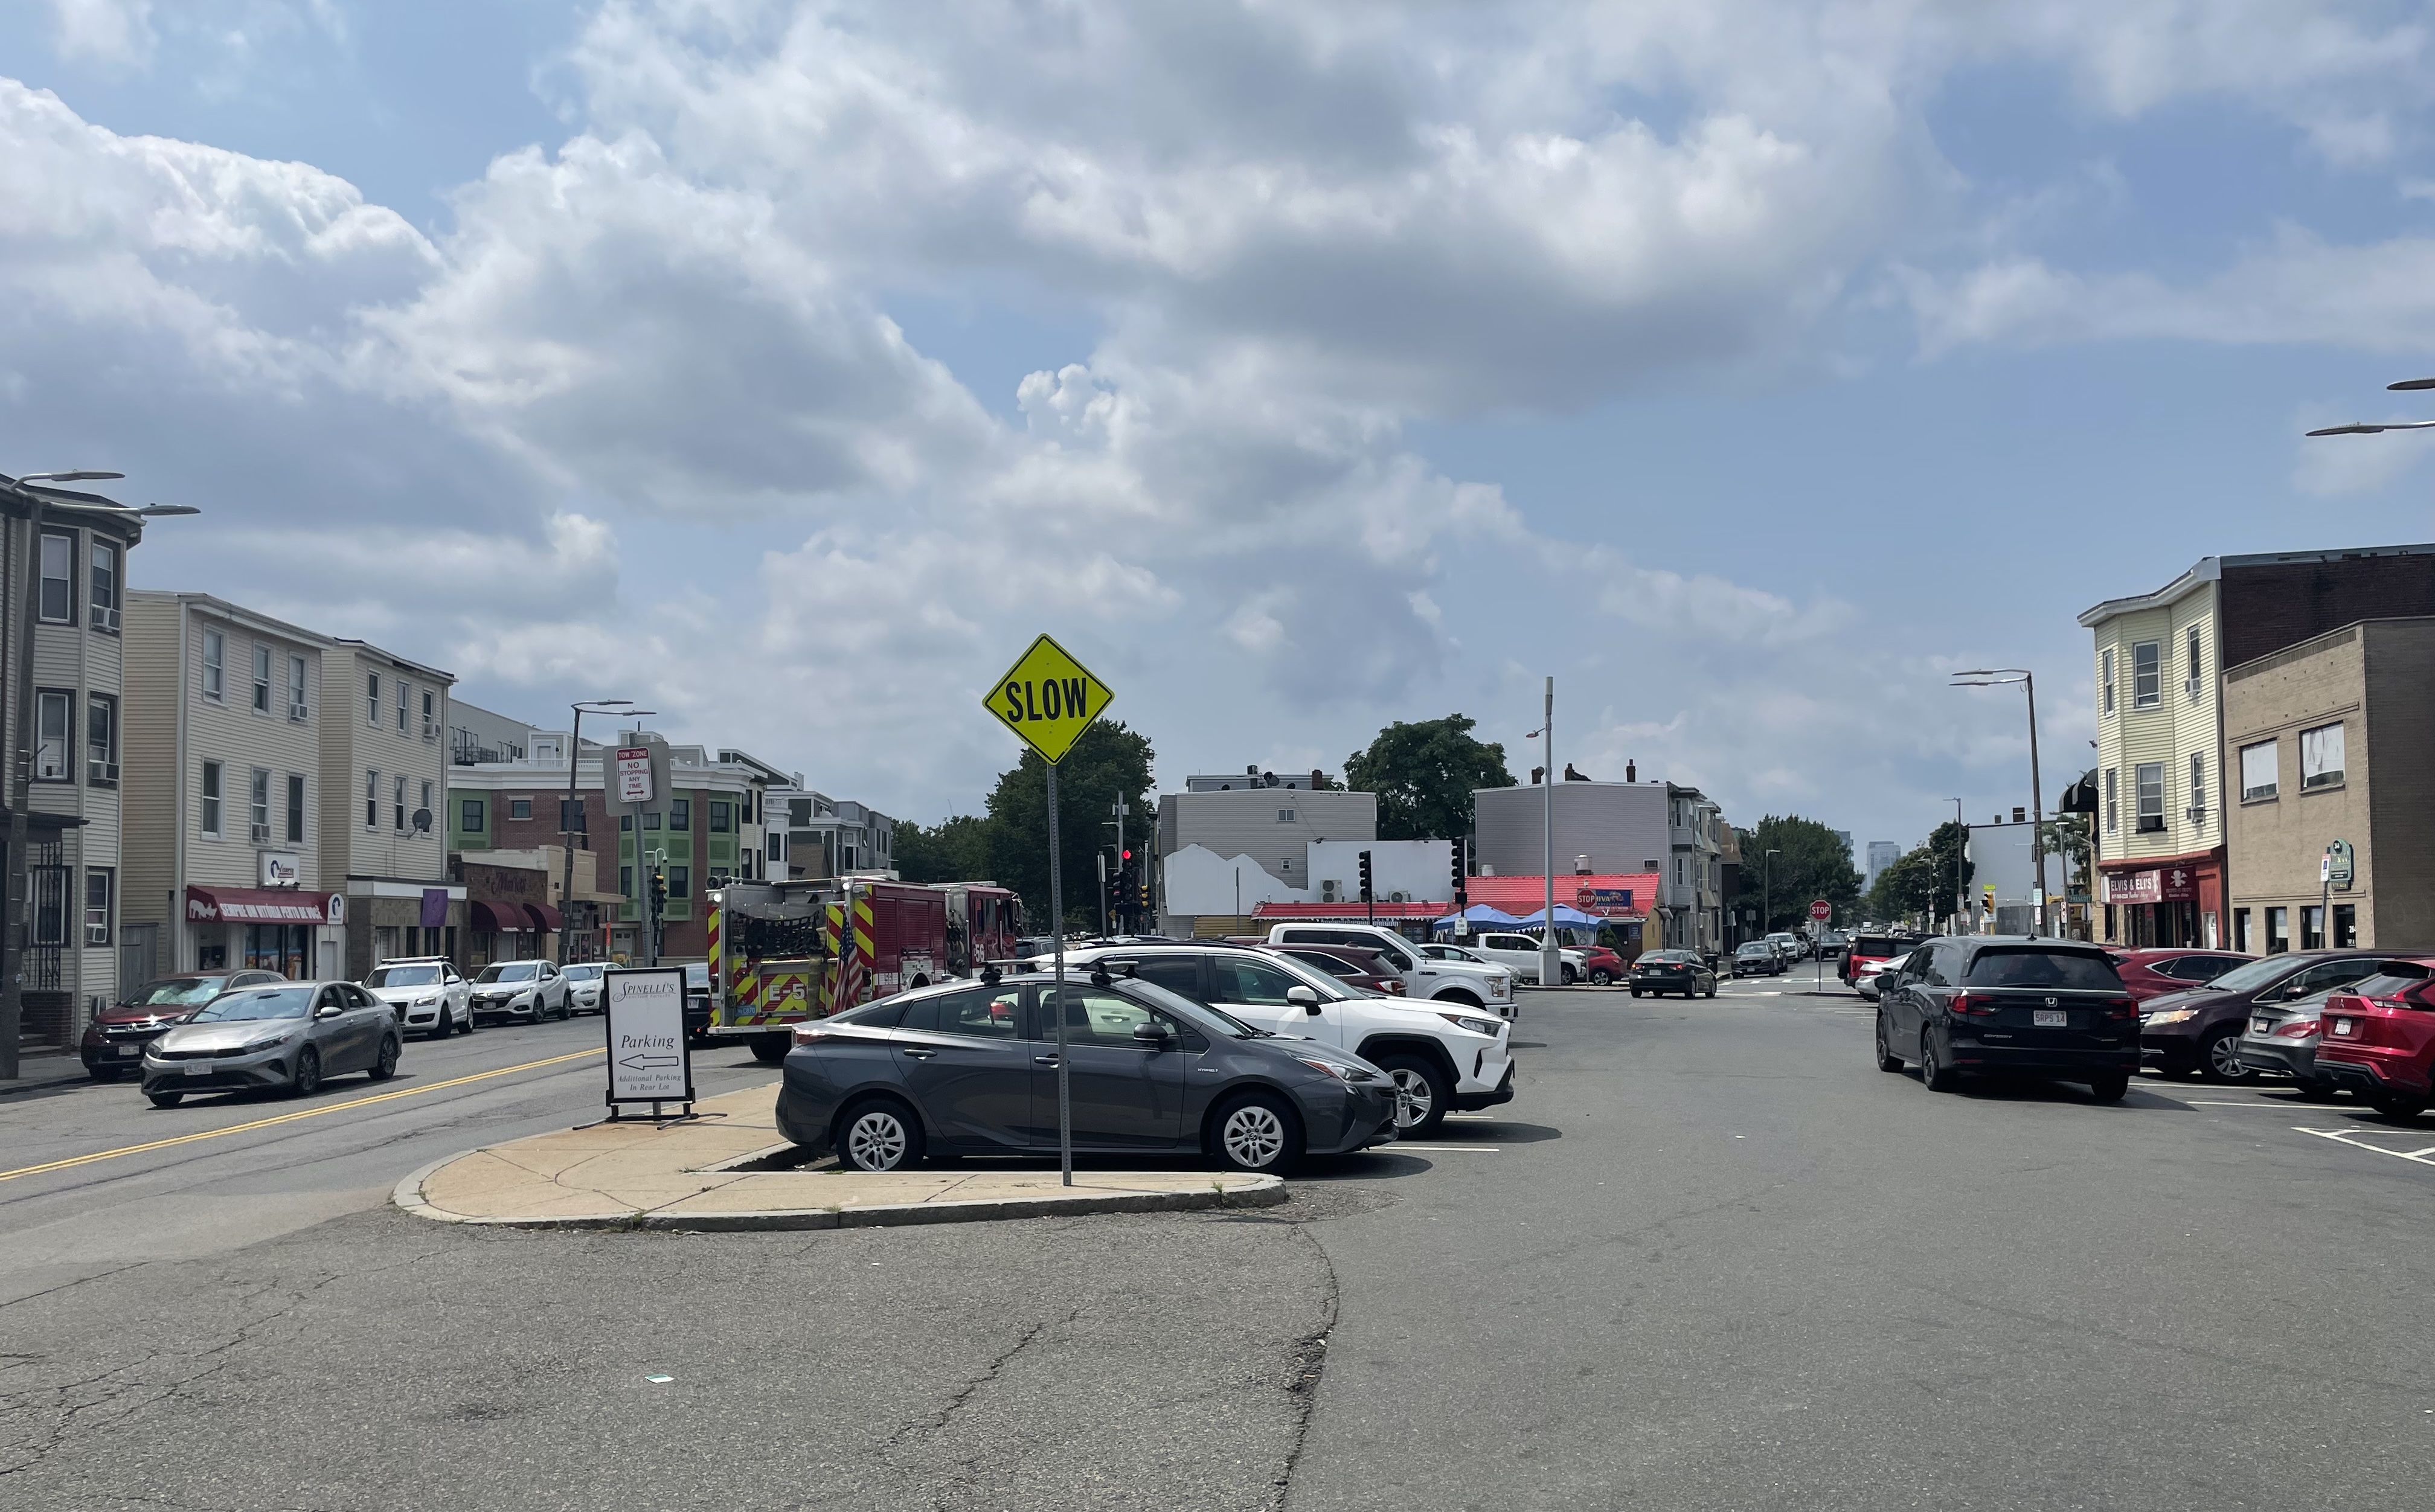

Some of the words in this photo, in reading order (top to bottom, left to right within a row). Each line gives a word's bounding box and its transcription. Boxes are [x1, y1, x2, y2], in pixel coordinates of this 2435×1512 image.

[1006, 678, 1086, 722] SLOW
[2110, 879, 2128, 891] ELVIS
[2129, 879, 2134, 891] &
[2135, 877, 2152, 890] ELI'S
[768, 983, 808, 1001] E-5
[2035, 1014, 2054, 1022] 5RPS
[621, 1034, 675, 1049] Parking
[617, 1074, 652, 1083] Additional
[655, 1074, 682, 1082] Parking
